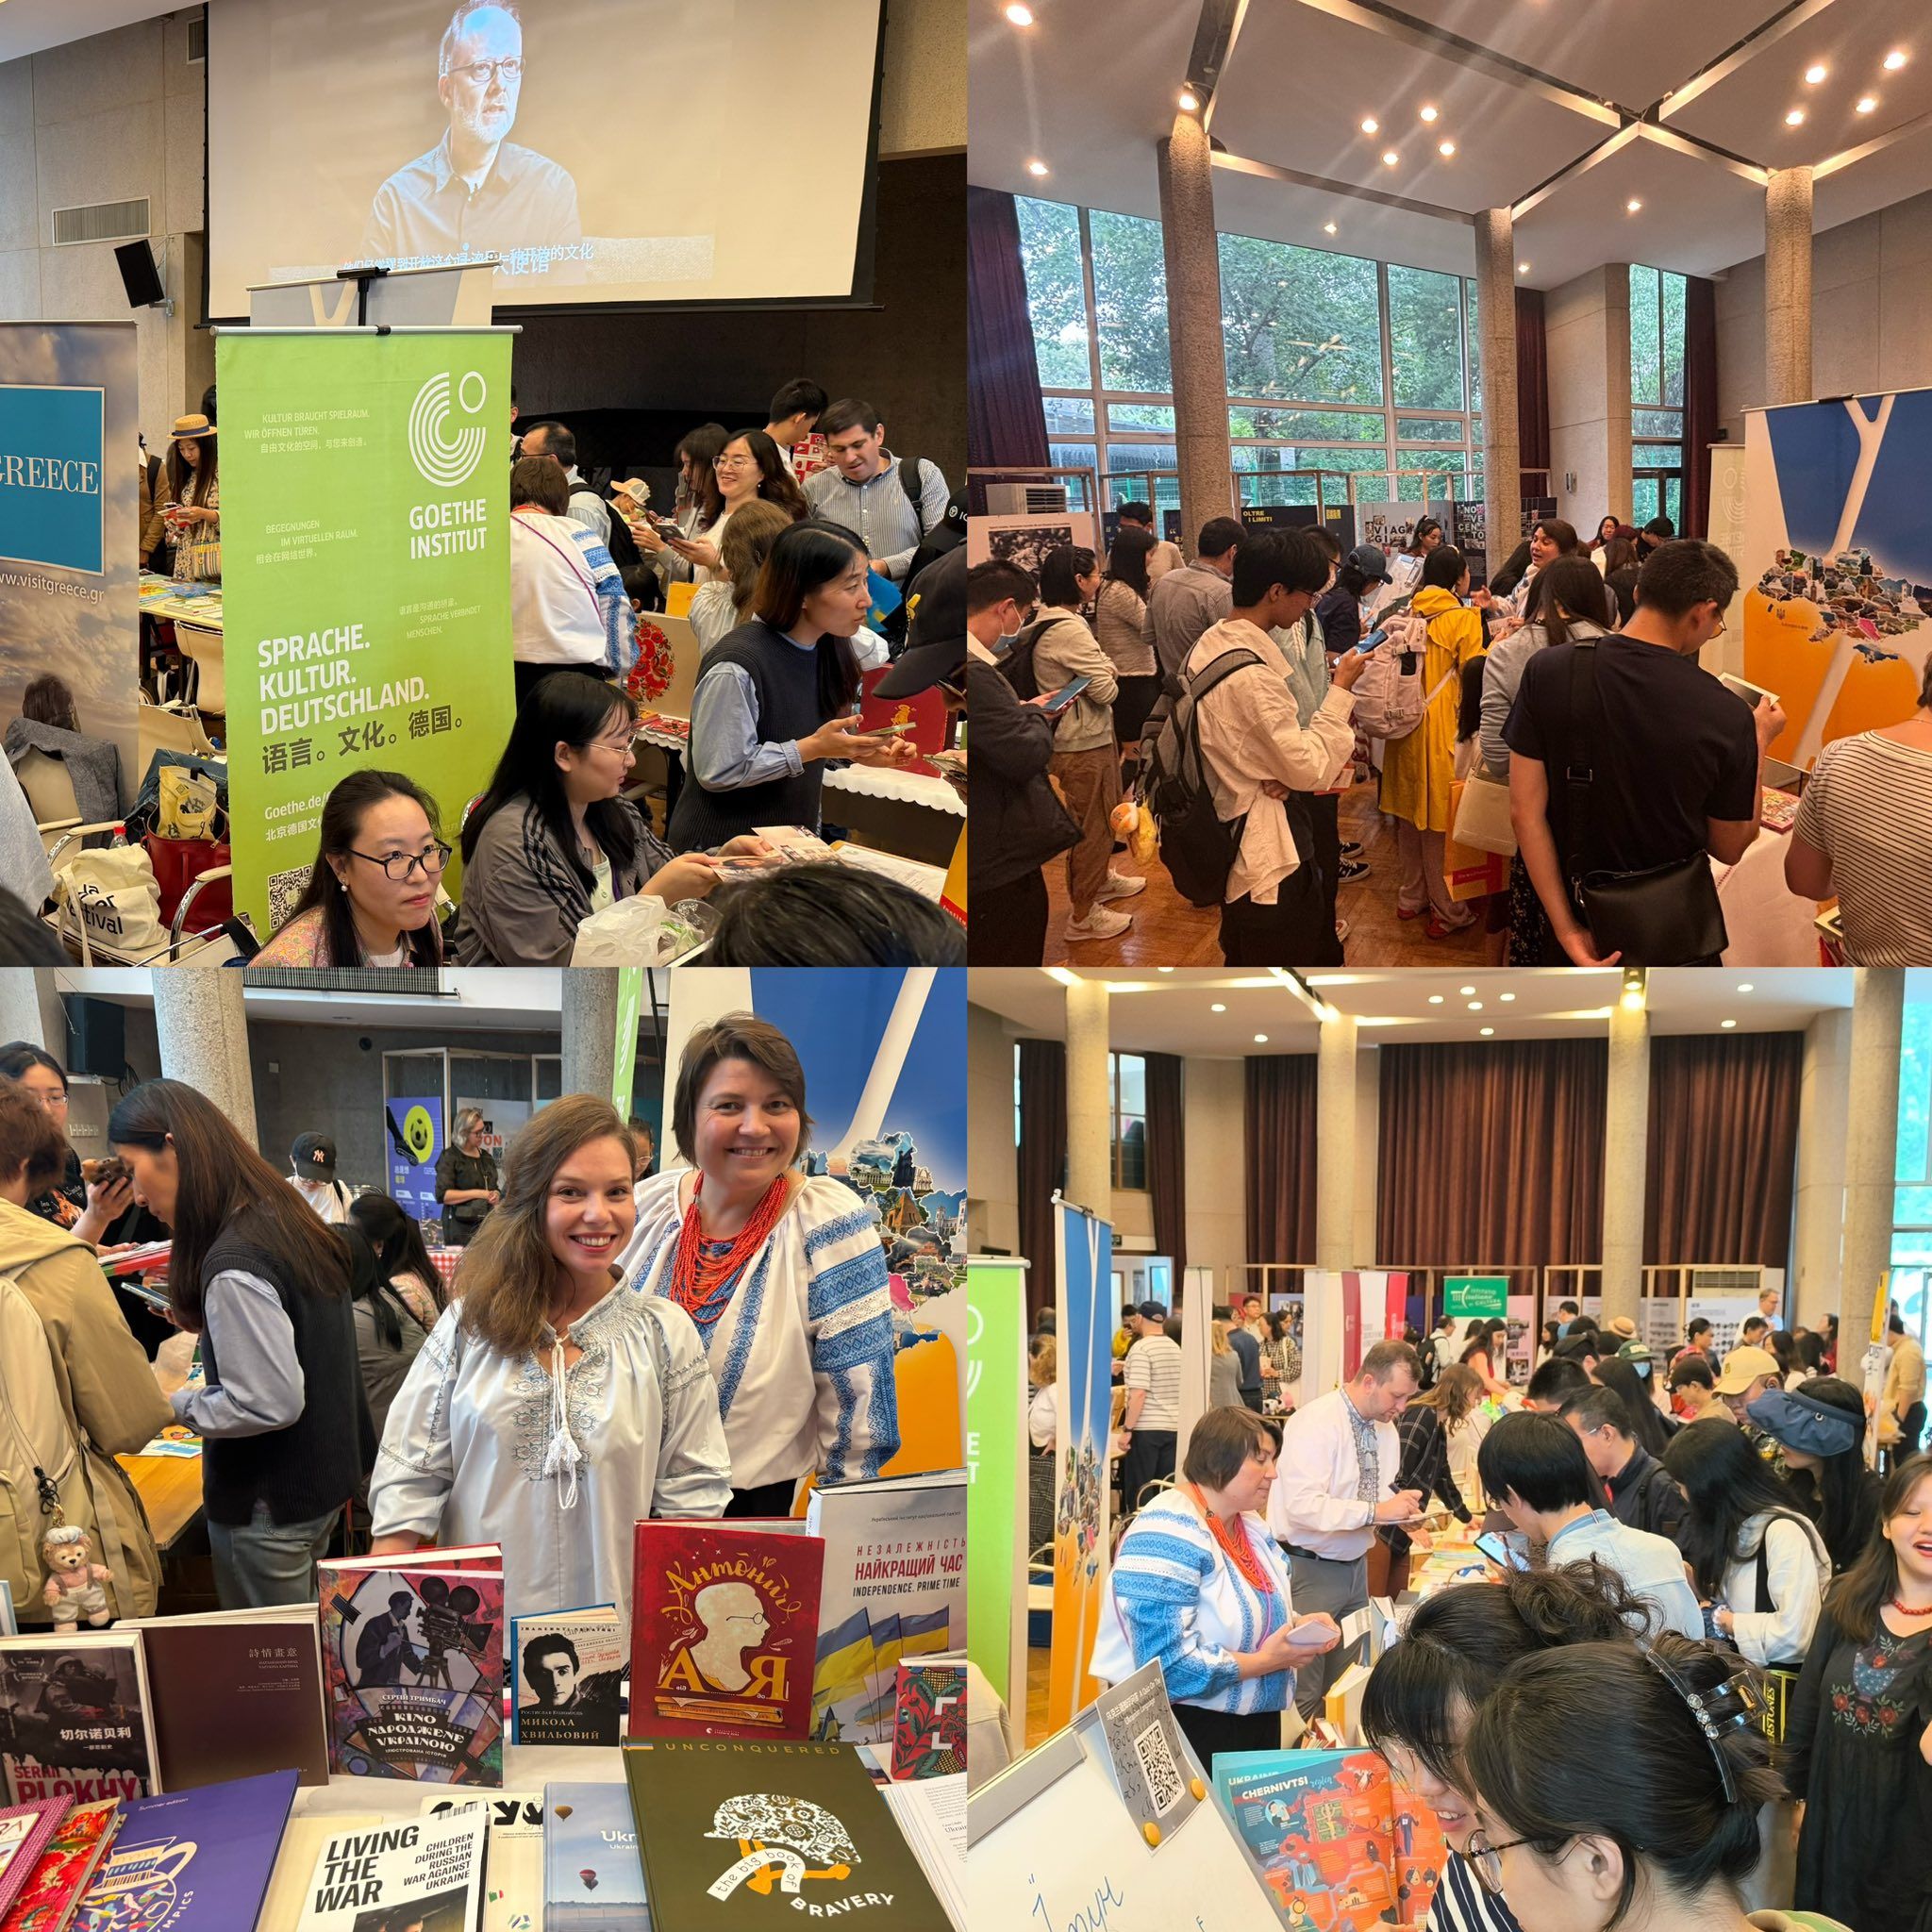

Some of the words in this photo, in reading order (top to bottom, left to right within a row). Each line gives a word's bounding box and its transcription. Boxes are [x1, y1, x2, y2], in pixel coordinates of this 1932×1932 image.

[262, 412, 292, 424] KULTUR
[294, 410, 327, 422] BRAUCHT
[243, 429, 259, 440] WIR
[261, 426, 292, 438] ÖFFNEN
[409, 498, 487, 530] GOETHE
[1471, 514, 1484, 523] VE
[265, 520, 320, 534] BEGEGNUNGEN
[280, 537, 291, 547] IM
[291, 531, 334, 545] VIRTUELLEN
[410, 527, 487, 559] INSTITUT
[258, 624, 371, 668] SPRACHE.
[259, 658, 357, 702] KULTUR.
[260, 675, 430, 736] DEUTSCHLAND.
[857, 1538, 967, 1557] НЕЗАЛЕЖНІСТЬ
[855, 1555, 936, 1581] НАЙКРАЩИЙ
[940, 1554, 964, 1573] ЧАС
[853, 1582, 915, 1597] INDEPENDENCE.
[917, 1580, 941, 1592] PRIME
[942, 1577, 961, 1589] TIME
[521, 1718, 575, 1726] МИКОЛА
[60, 1726, 132, 1740] 切尔诺贝利
[521, 1730, 600, 1740] ХВИЛЬОВИЙ
[665, 1743, 840, 1755] UNCONQUERED
[1241, 1775, 1308, 1800] CHERNIVTSI
[139, 1803, 165, 1811] Summer
[326, 1825, 419, 1862] LIVING
[414, 1847, 453, 1864] DURING
[455, 1842, 473, 1856] THE
[425, 1832, 474, 1853] CHILDREN
[324, 1856, 378, 1886] THE
[428, 1851, 472, 1870] RUSSIAN
[403, 1874, 426, 1887] WAR
[427, 1860, 471, 1880] AGAINST
[425, 1870, 471, 1890] UKRAINE
[716, 1872, 738, 1893] the
[740, 1857, 762, 1874] big
[765, 1850, 801, 1870] book
[786, 1873, 798, 1888] of
[314, 1879, 383, 1914] WAR
[791, 1892, 895, 1918] BRAVERY
